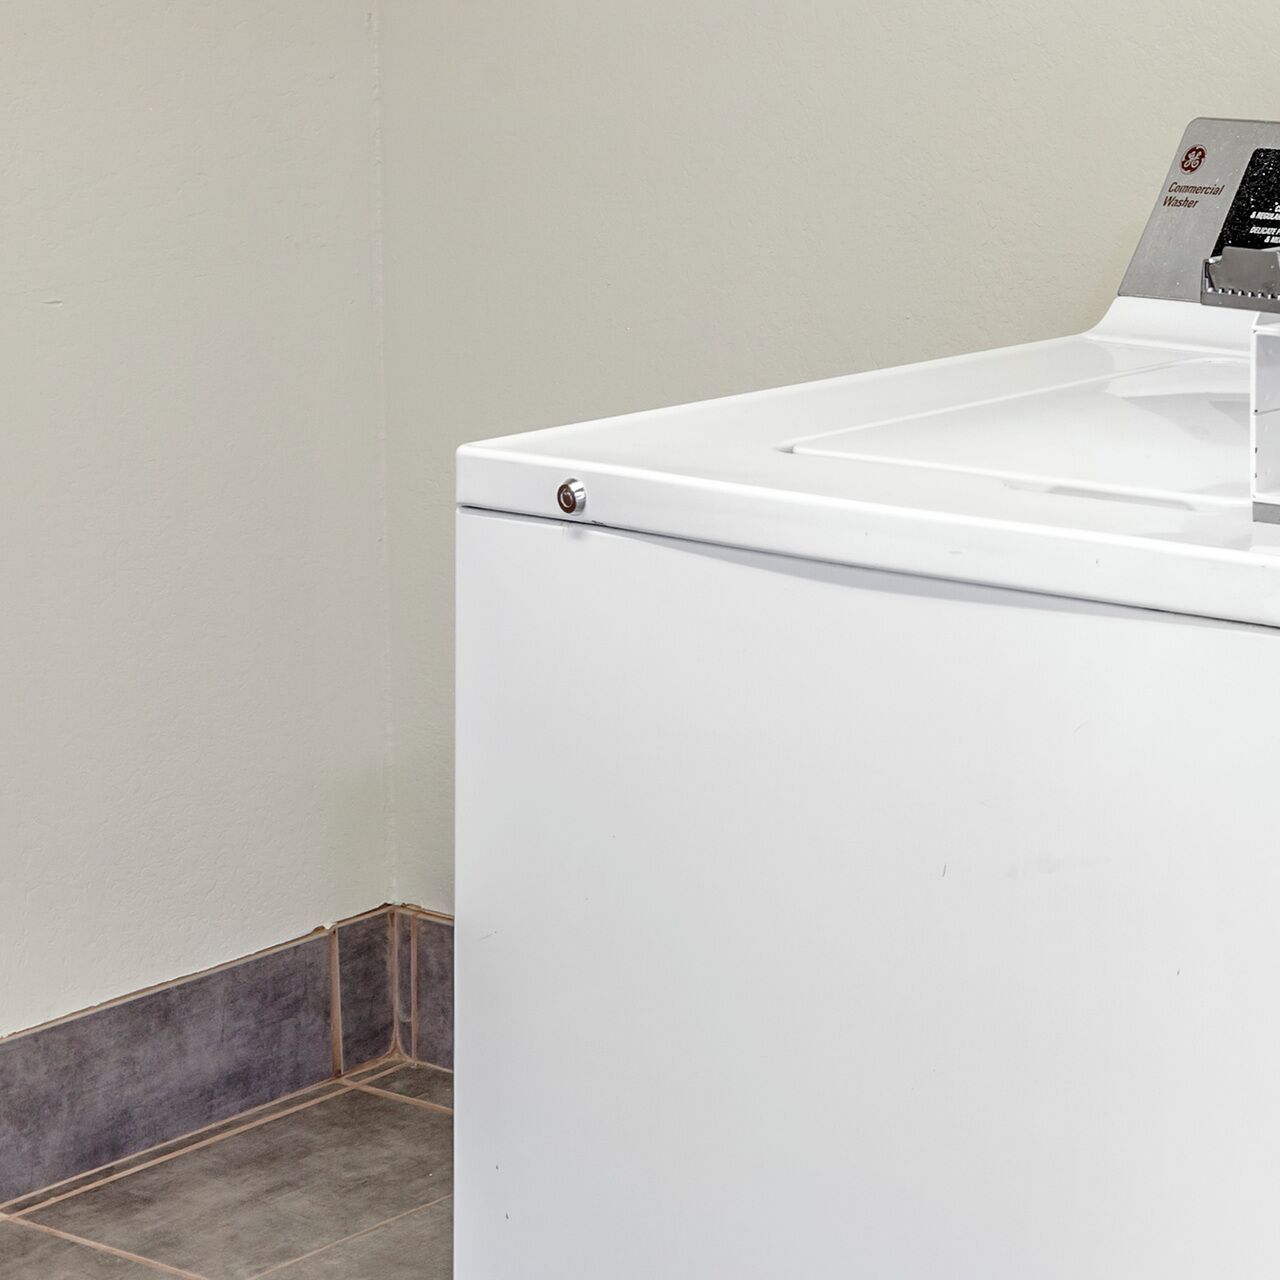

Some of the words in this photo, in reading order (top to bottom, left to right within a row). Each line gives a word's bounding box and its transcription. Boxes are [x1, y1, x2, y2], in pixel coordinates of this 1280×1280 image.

[1168, 182, 1225, 196] Commercial
[1163, 195, 1199, 209] Washer
[1249, 226, 1277, 236] DELICATE
